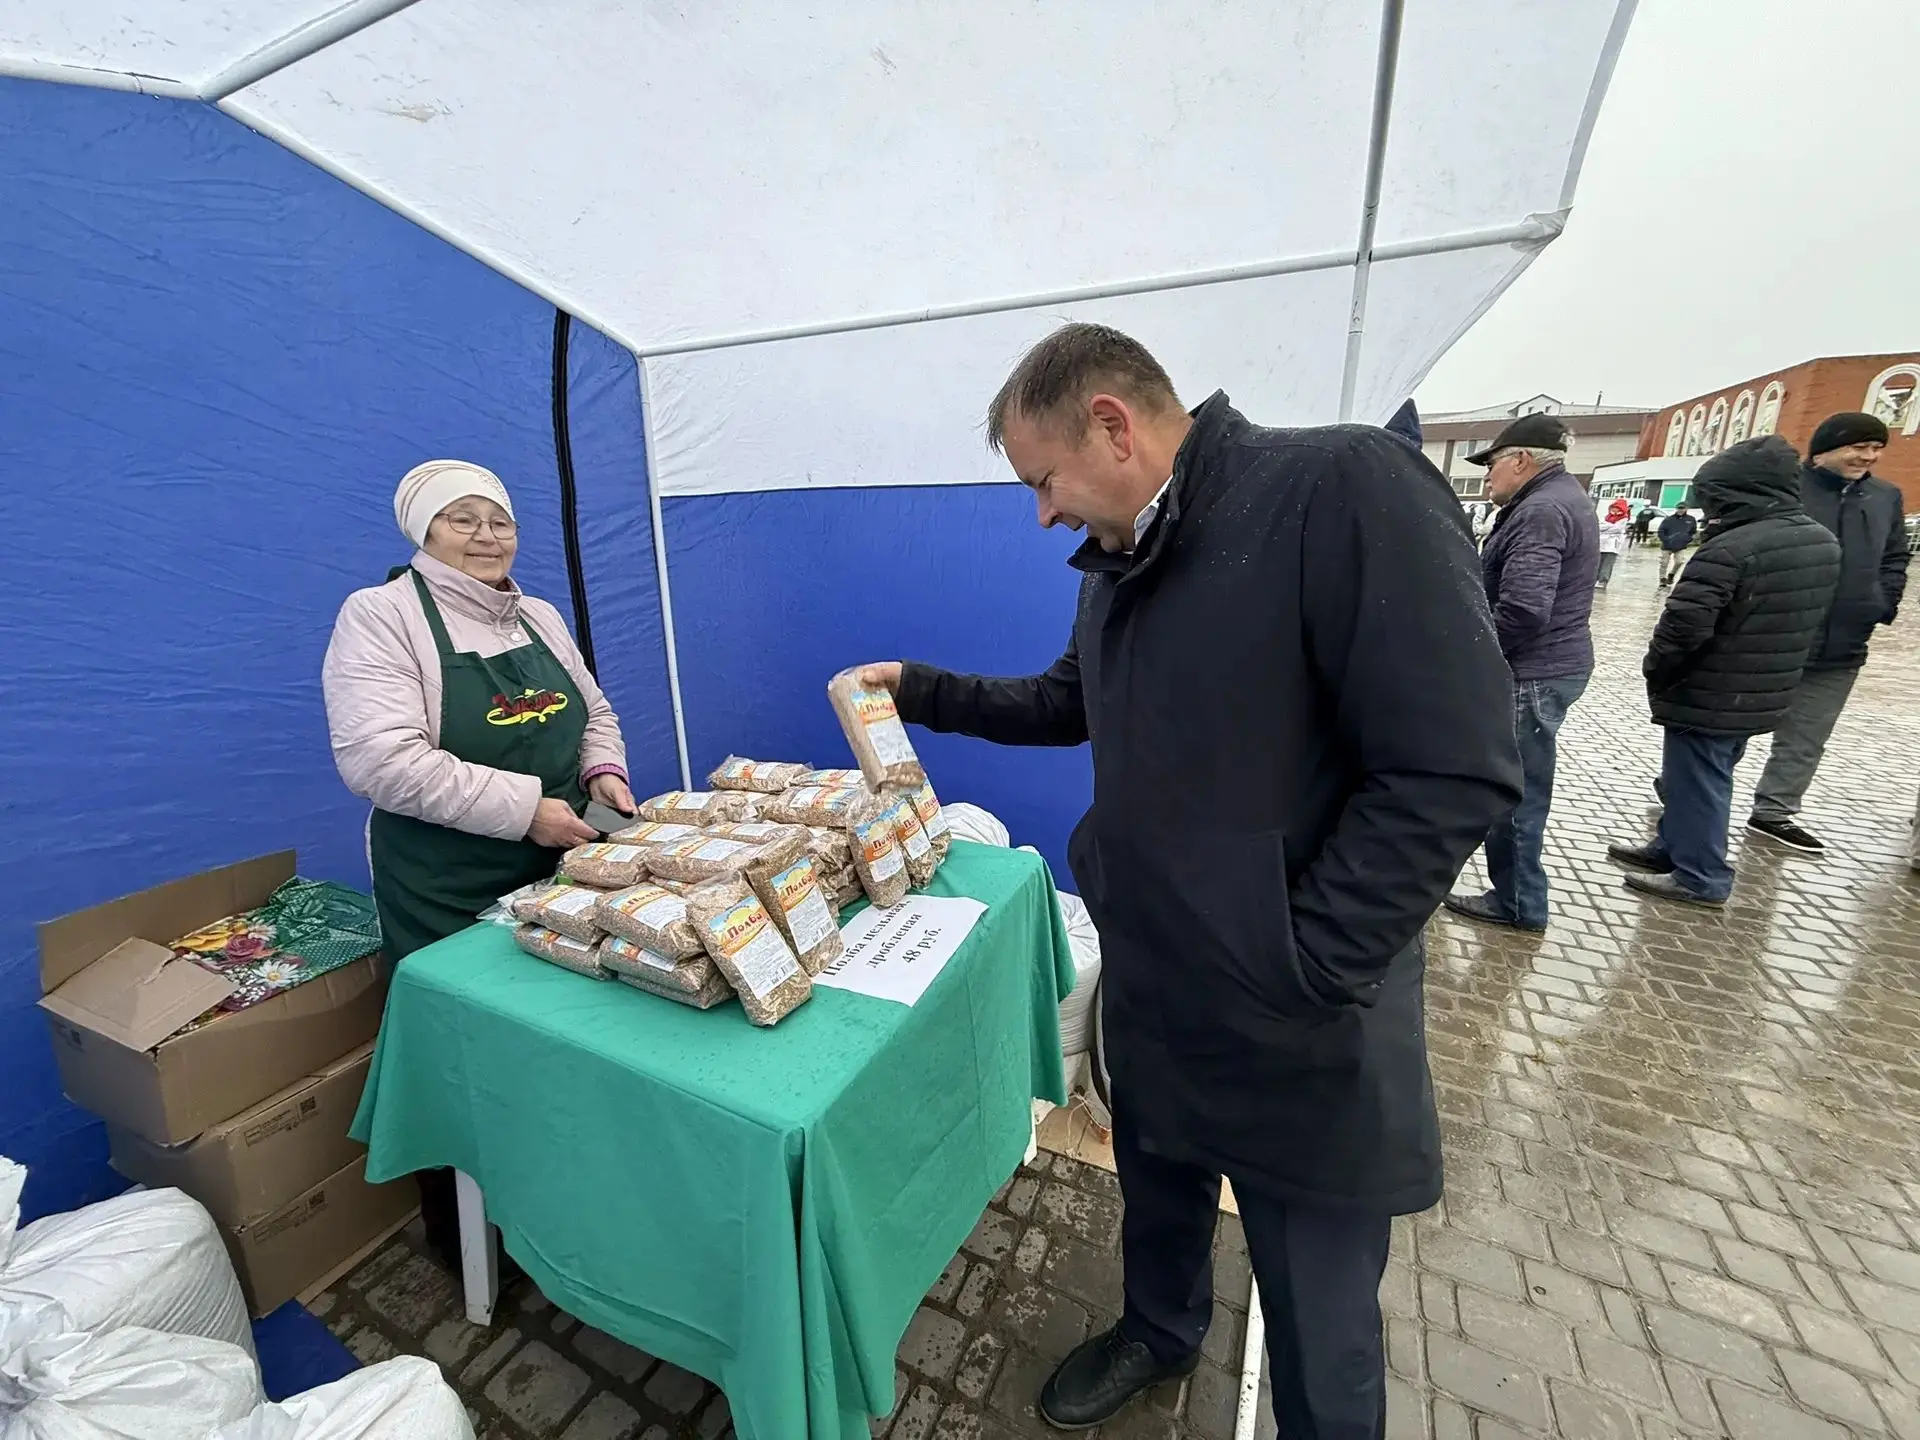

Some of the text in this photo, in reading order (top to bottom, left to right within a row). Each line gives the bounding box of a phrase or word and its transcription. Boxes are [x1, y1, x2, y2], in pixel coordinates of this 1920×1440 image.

[726, 911, 763, 939] Полба
[822, 942, 865, 977] Полба
[902, 927, 942, 964] 48 руб.
